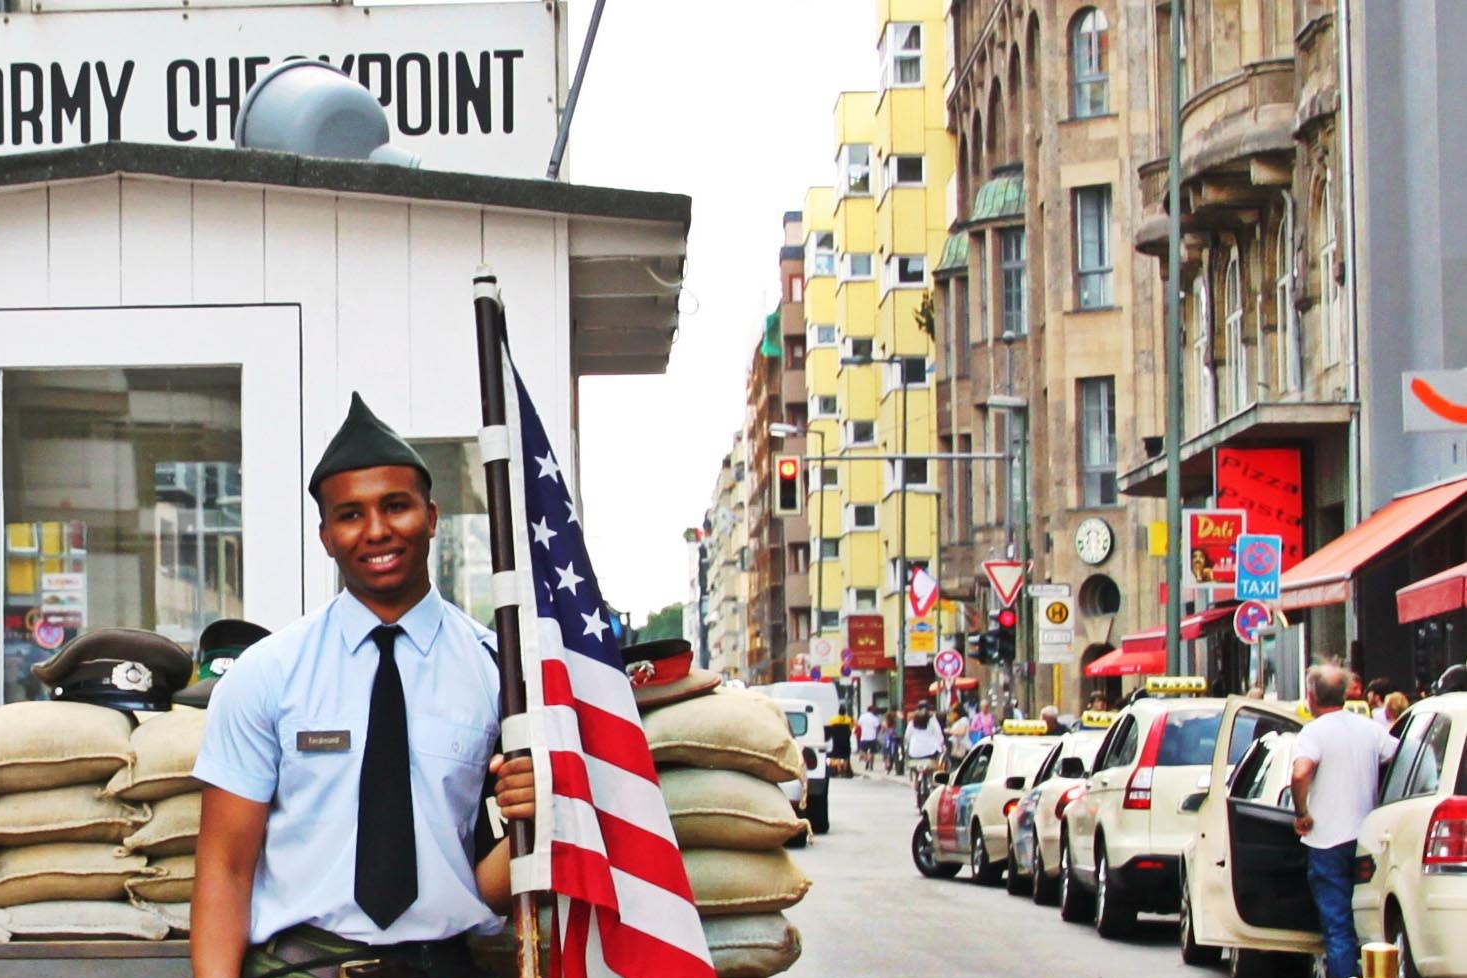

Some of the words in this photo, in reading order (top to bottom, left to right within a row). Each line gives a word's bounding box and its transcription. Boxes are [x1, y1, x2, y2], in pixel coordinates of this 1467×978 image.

[166, 49, 524, 142] CHPOINT
[1220, 455, 1300, 495] Pizza
[1218, 485, 1302, 528] Pasta
[1241, 579, 1276, 596] TAXI
